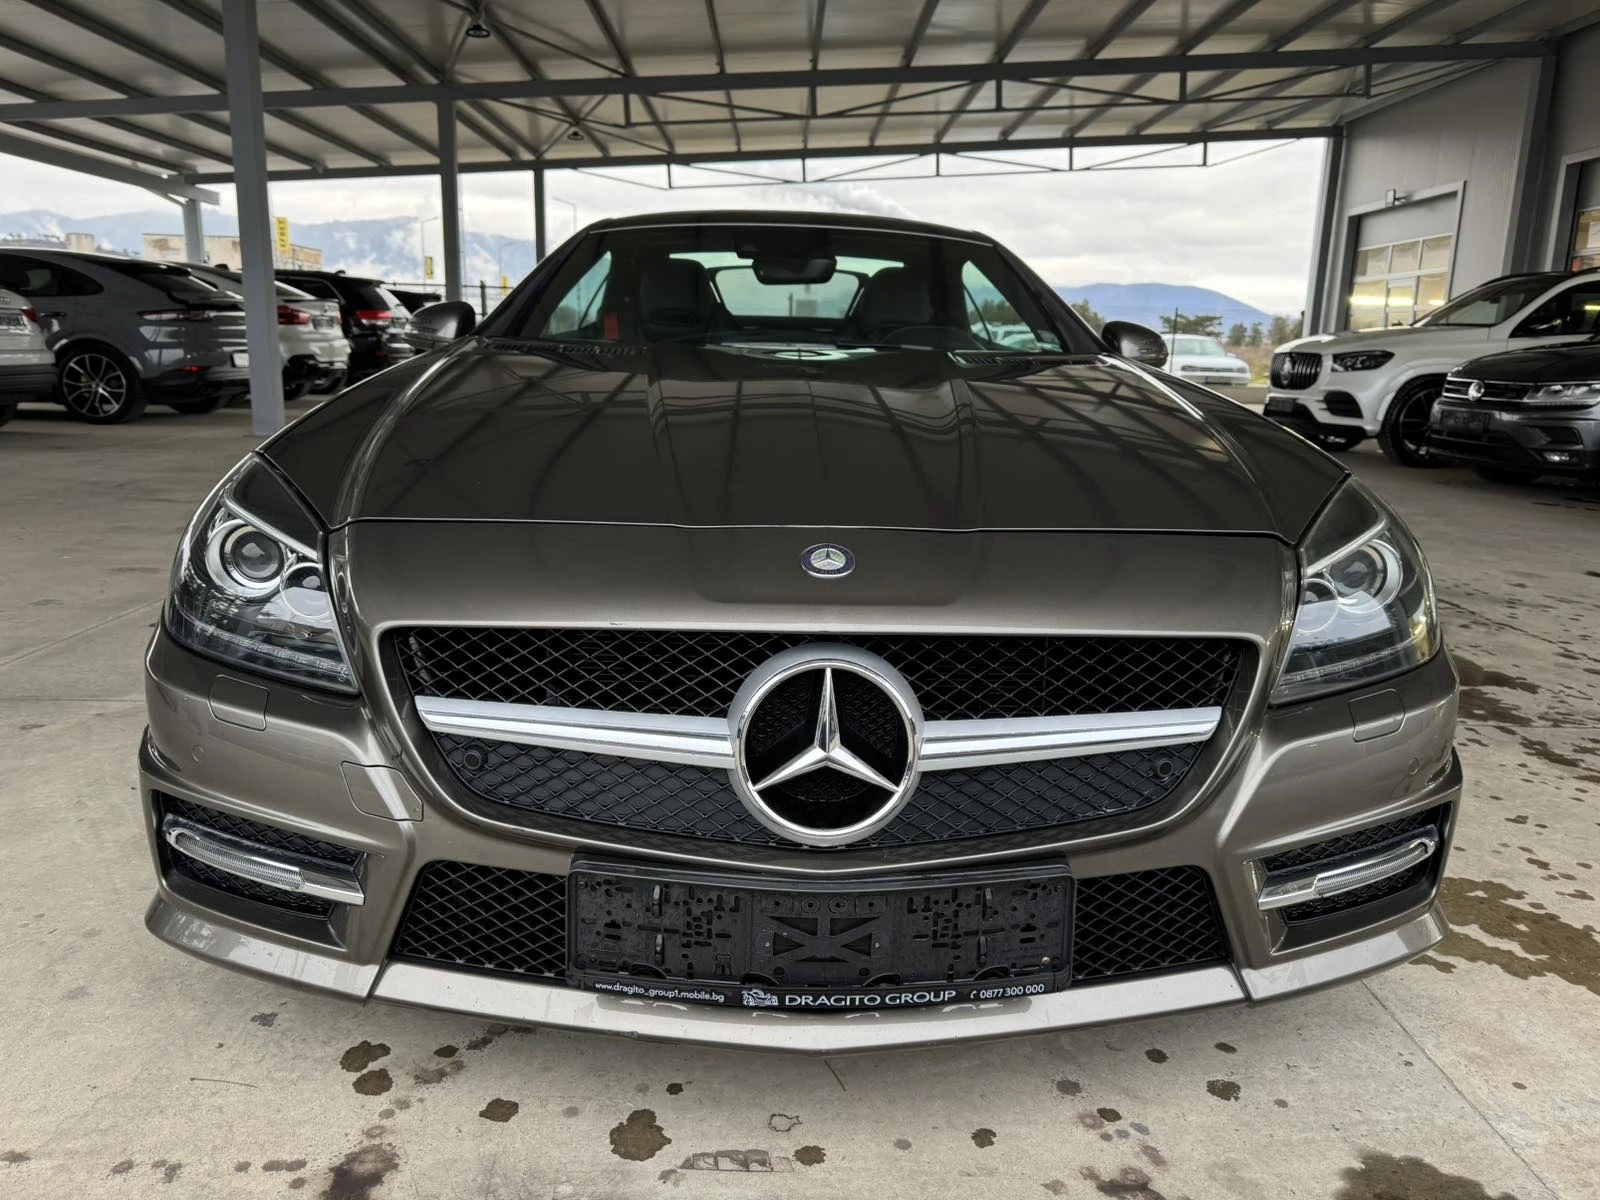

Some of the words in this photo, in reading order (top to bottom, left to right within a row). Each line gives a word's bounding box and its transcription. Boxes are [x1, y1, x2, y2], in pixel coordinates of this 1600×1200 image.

[595, 983, 725, 1003] www.dragito_group1.mobile.bg
[785, 994, 881, 1006] DRAGITO
[885, 990, 957, 1005] GROUP
[980, 988, 1004, 999] 0877
[1004, 986, 1024, 997] 300
[1025, 983, 1045, 994] 000
